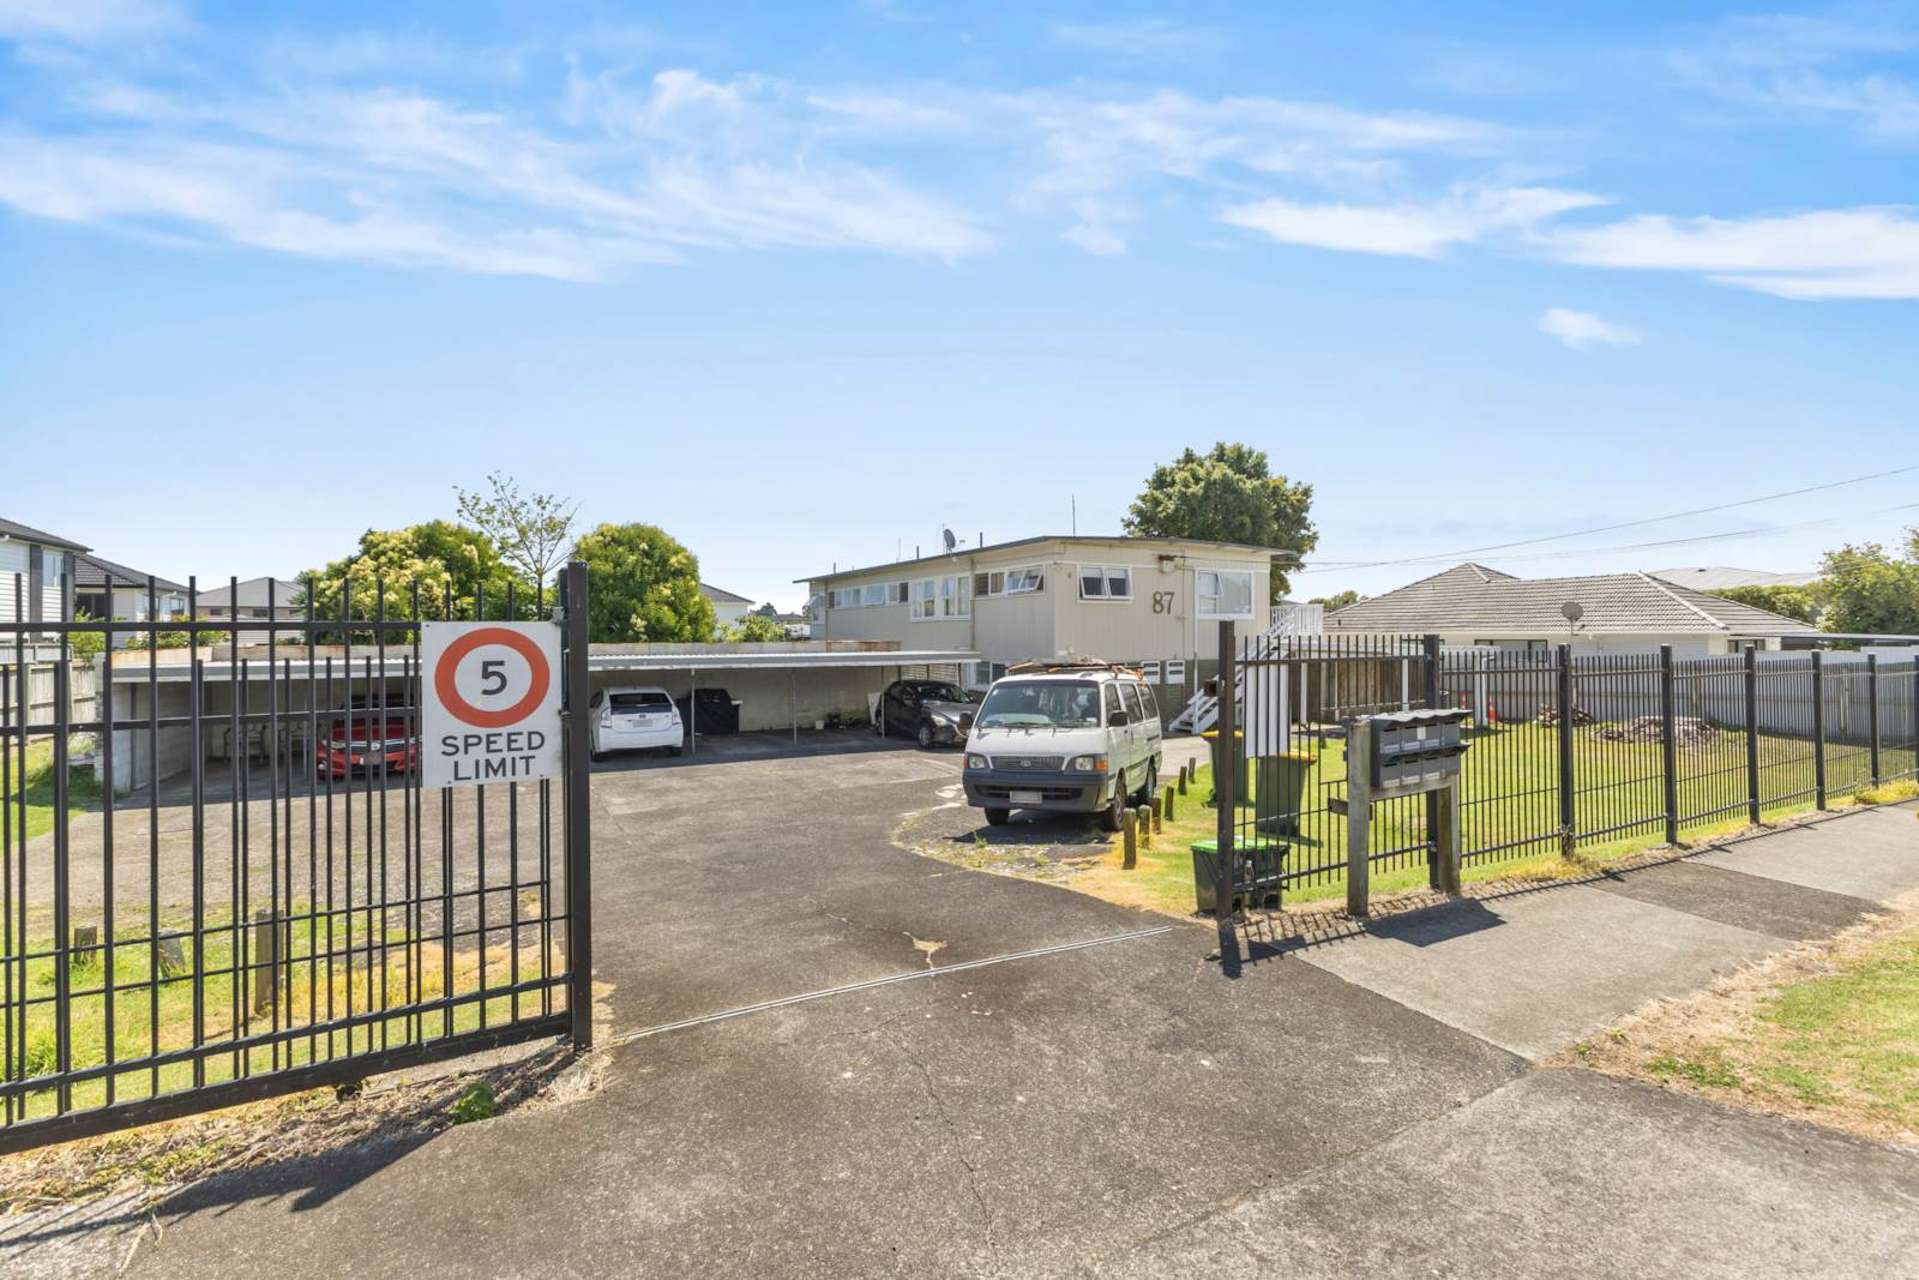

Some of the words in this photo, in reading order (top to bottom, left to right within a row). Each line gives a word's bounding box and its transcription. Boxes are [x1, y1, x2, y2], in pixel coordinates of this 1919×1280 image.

[1152, 591, 1175, 615] 87
[481, 660, 507, 695] 5
[441, 731, 545, 756] SPEED
[454, 755, 536, 781] LIMIT
